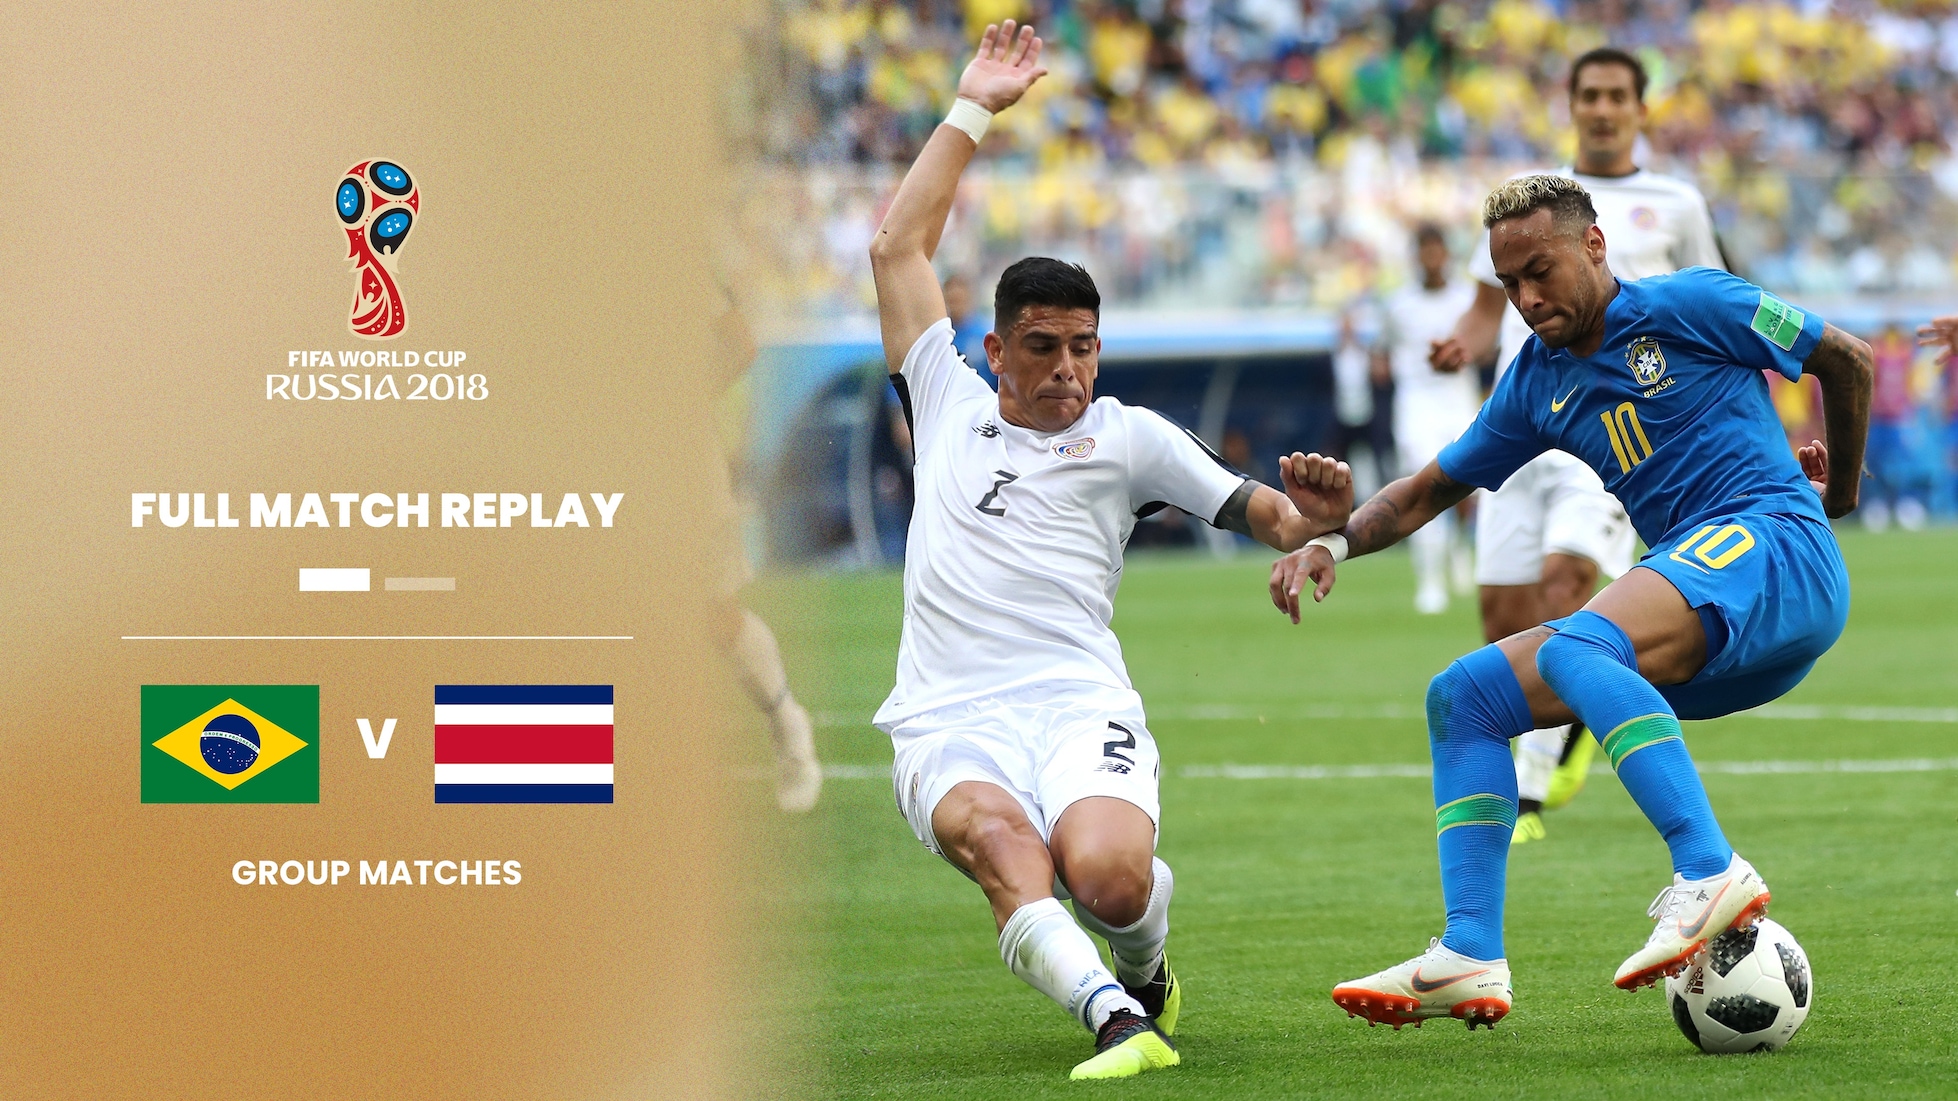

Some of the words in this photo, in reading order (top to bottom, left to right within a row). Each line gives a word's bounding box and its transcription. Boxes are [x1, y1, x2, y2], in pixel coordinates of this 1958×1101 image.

[1643, 376, 1677, 399] BRASIL
[1600, 401, 1654, 475] 10
[975, 469, 1020, 517] 2
[1675, 524, 1756, 570] 10
[1103, 720, 1136, 766] 2
[1079, 969, 1103, 988] RICA
[1683, 966, 1703, 995] adidas
